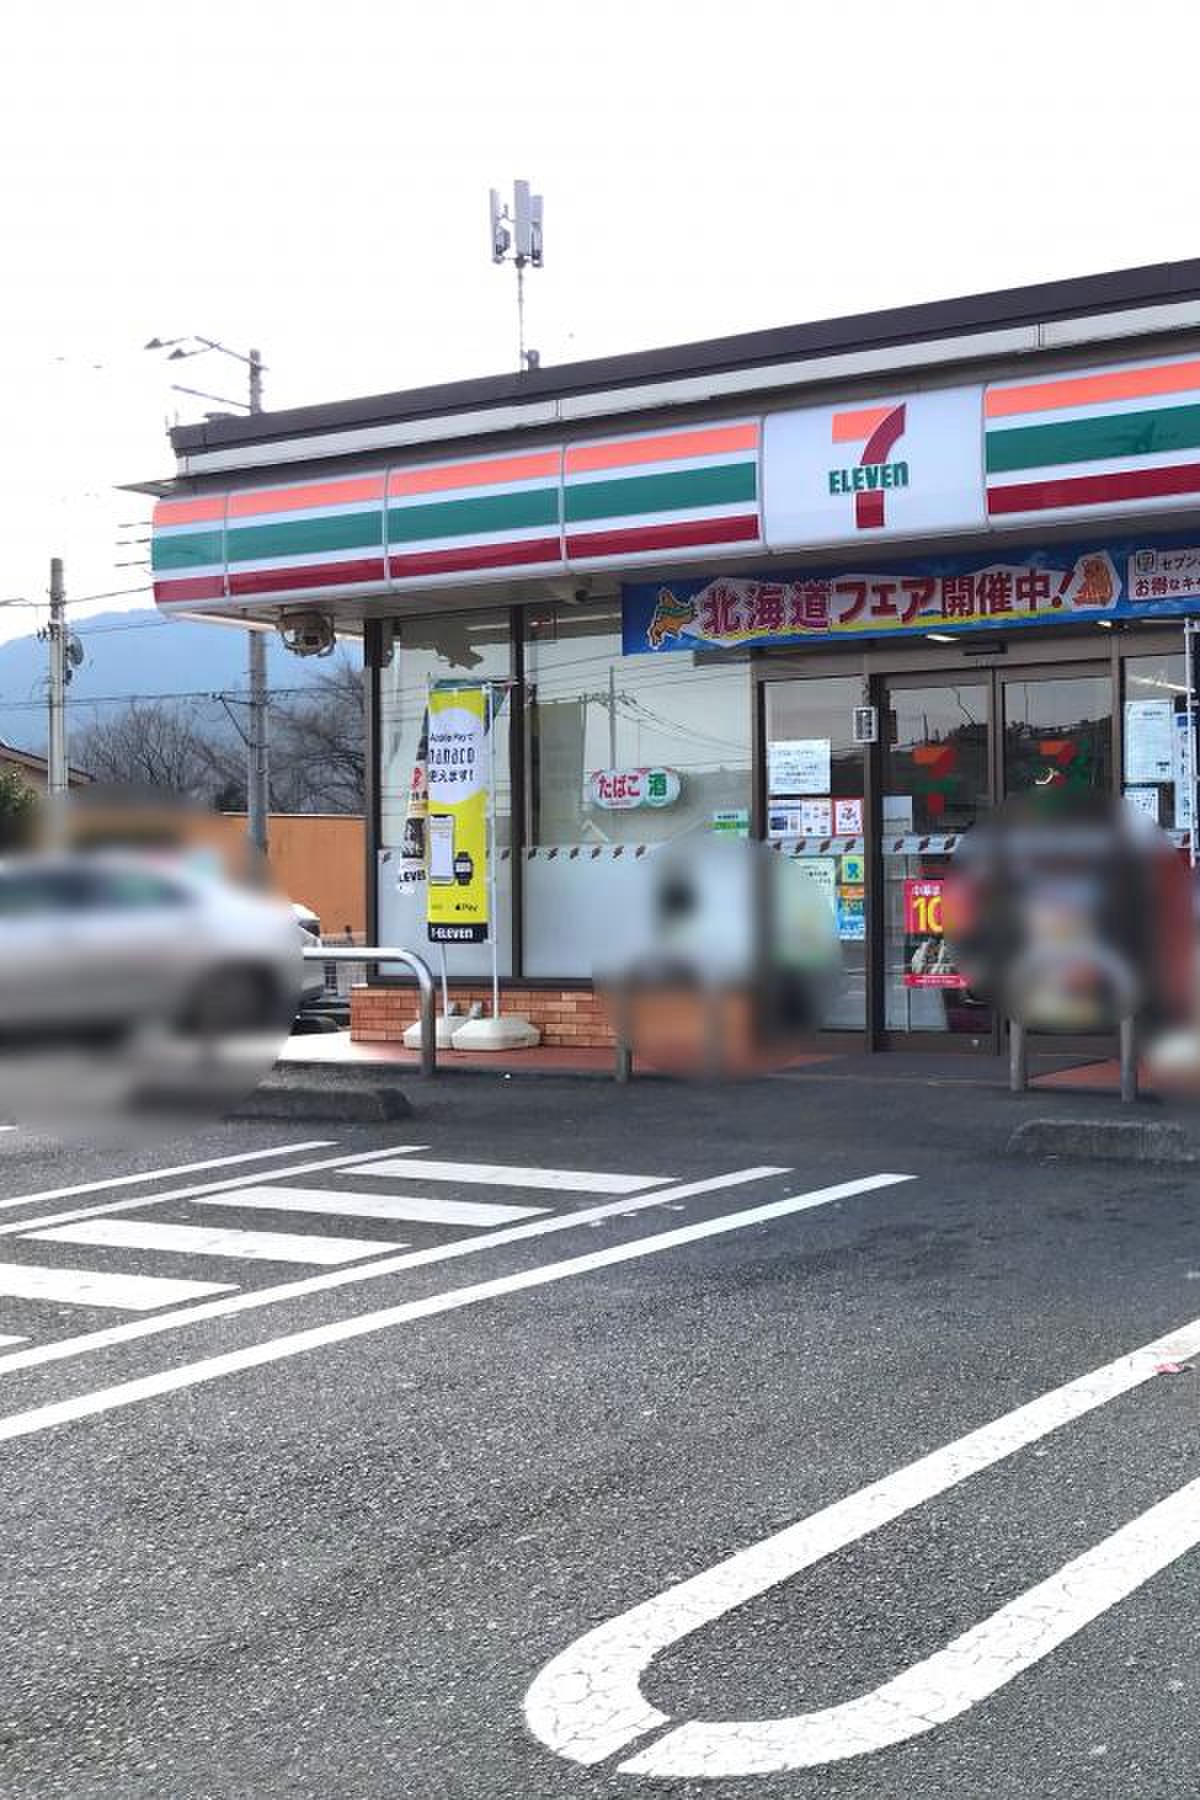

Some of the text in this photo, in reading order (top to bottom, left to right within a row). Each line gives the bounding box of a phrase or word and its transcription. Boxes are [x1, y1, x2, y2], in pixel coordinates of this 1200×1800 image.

[832, 402, 906, 528] 7
[702, 567, 1075, 635] 北海道フェア開催中!
[598, 773, 668, 799] たばこ 酒
